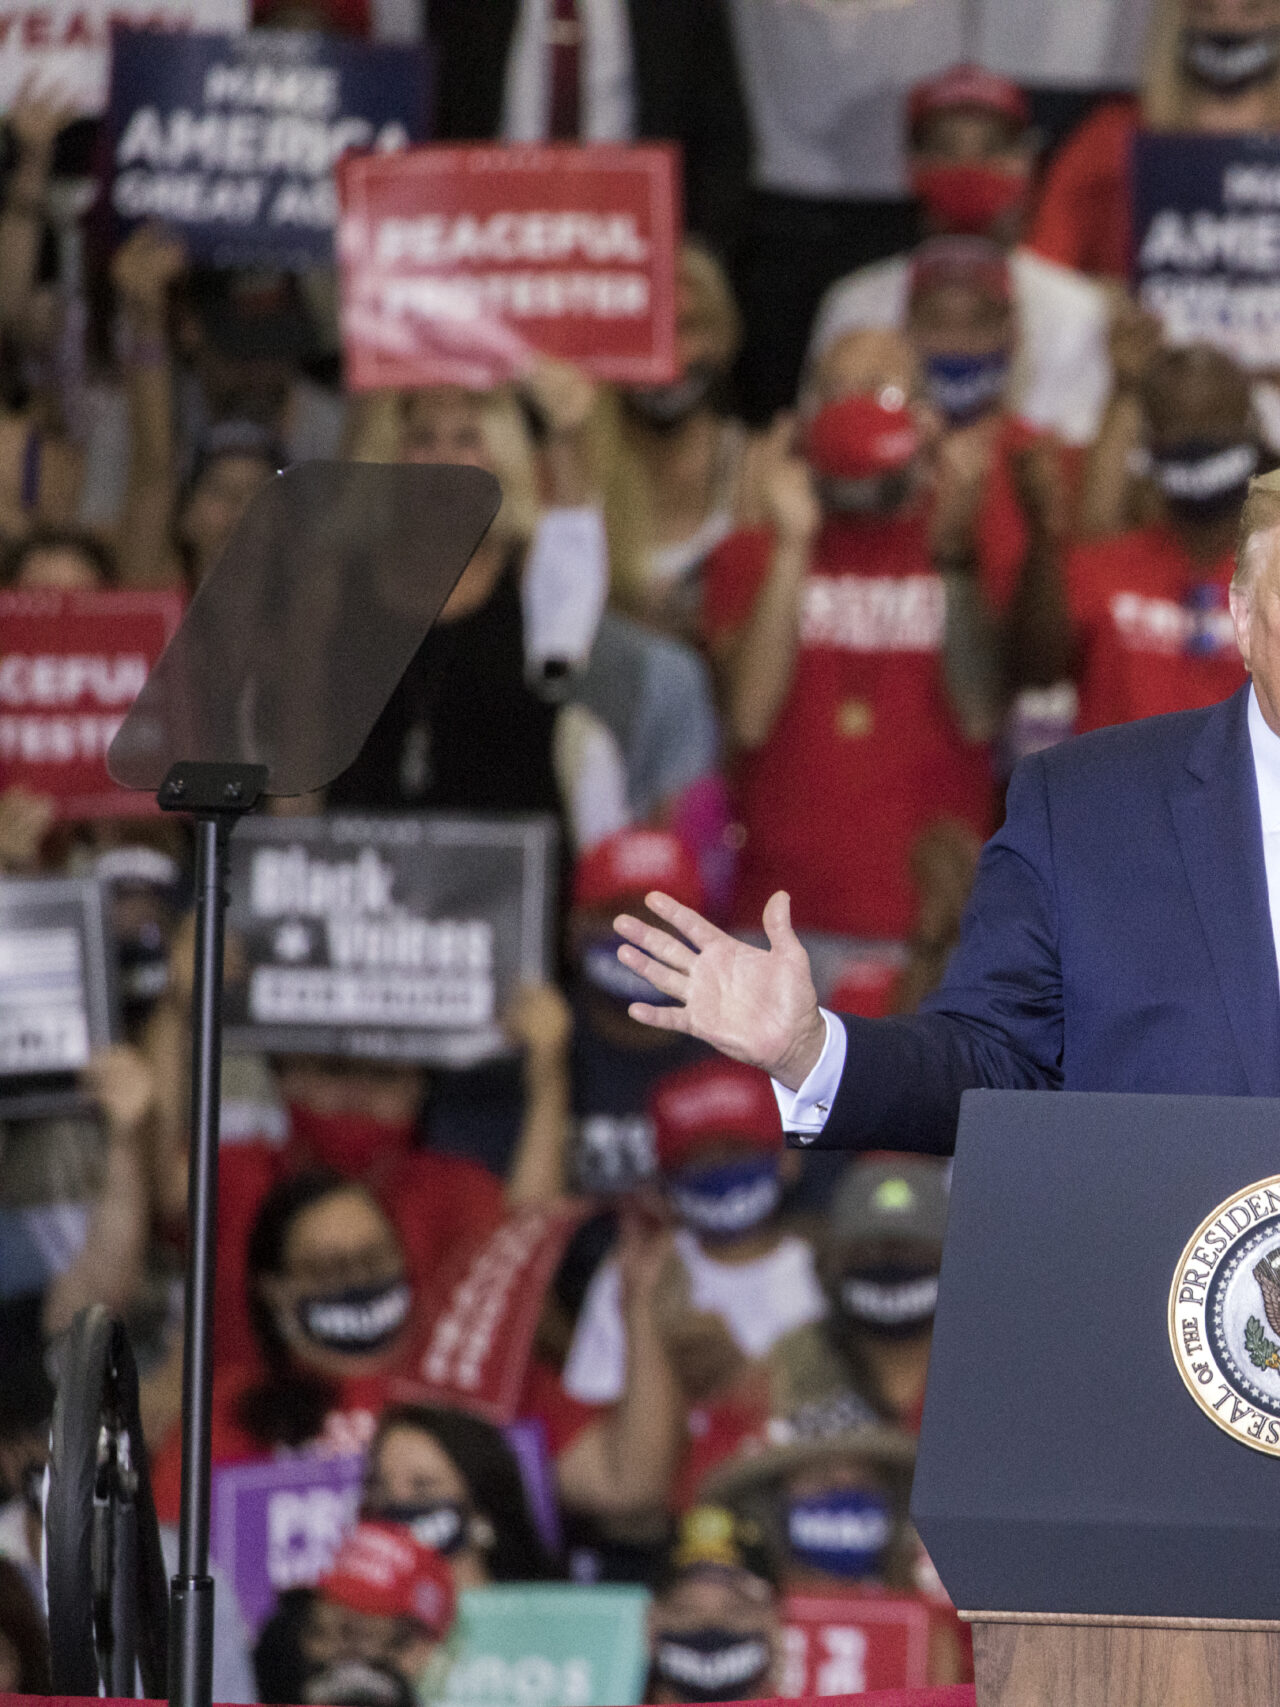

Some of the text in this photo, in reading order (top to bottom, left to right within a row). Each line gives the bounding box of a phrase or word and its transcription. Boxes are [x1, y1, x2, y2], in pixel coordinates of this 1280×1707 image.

[376, 210, 650, 262] PEACEFUL
[252, 846, 394, 916] Black
[1181, 1316, 1204, 1357] THE
[1192, 1362, 1213, 1386] OF
